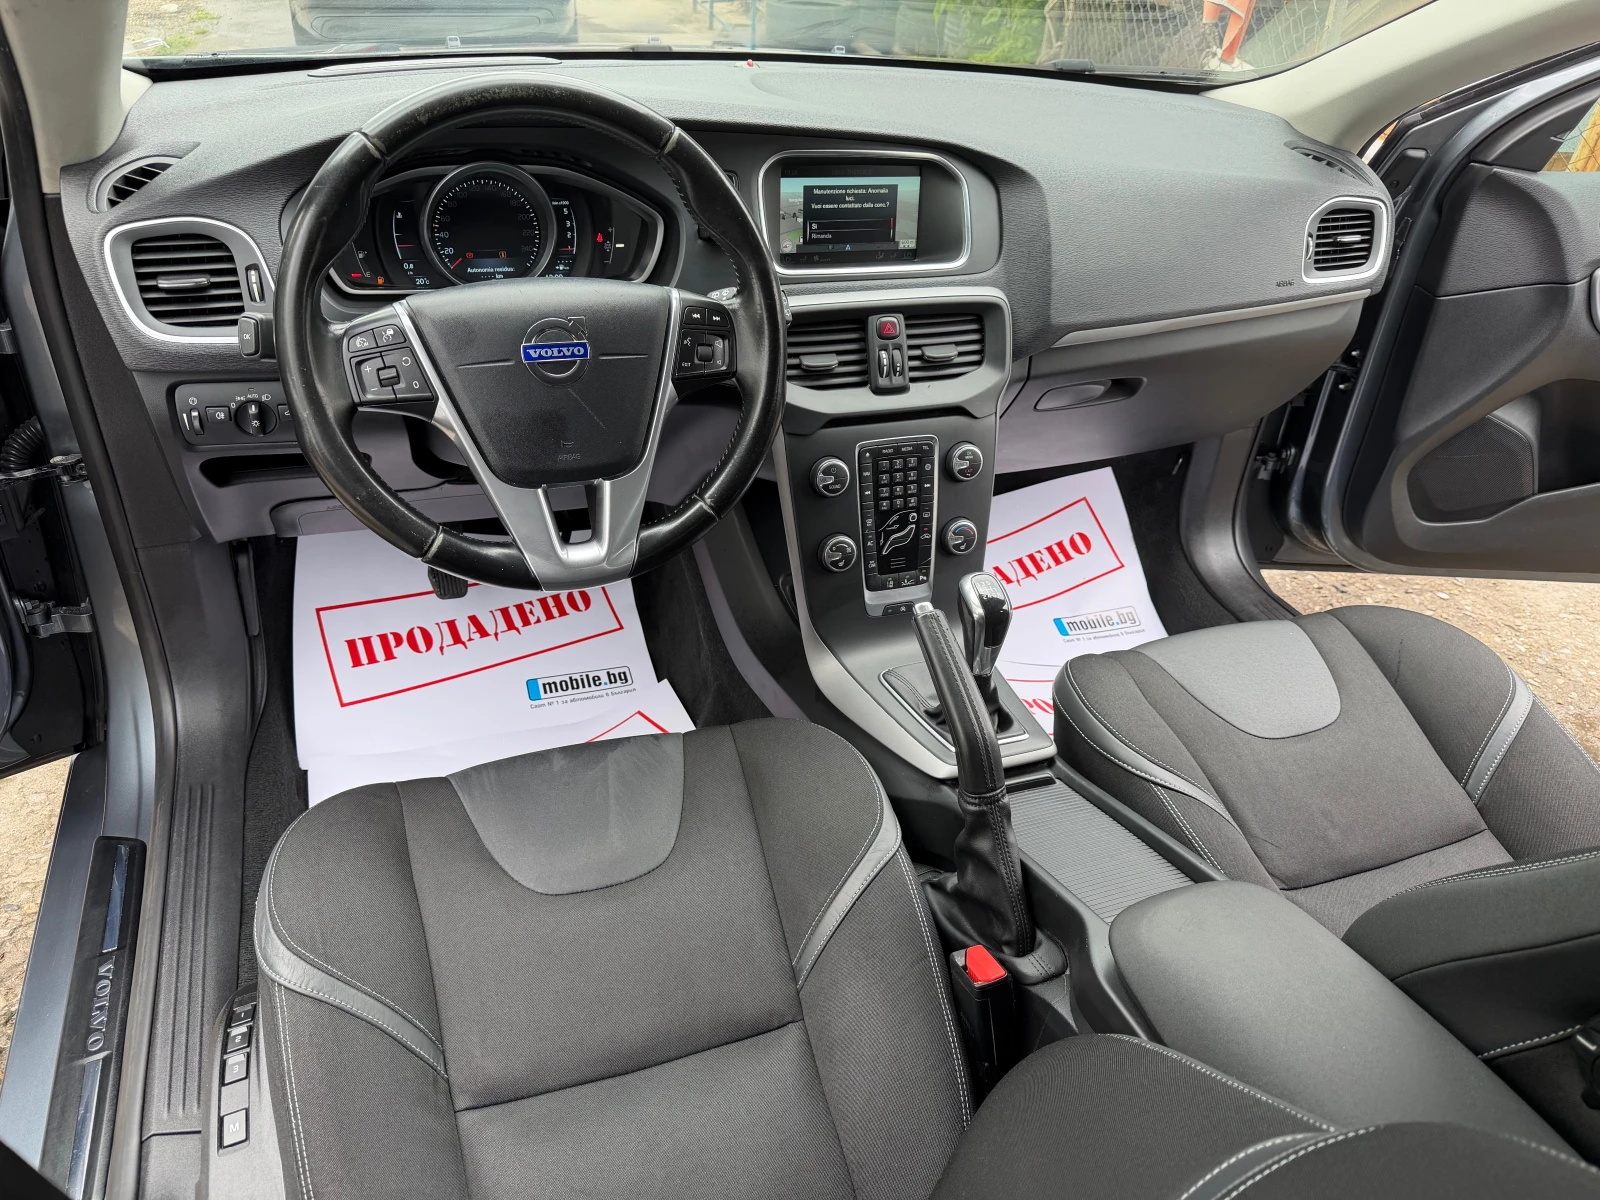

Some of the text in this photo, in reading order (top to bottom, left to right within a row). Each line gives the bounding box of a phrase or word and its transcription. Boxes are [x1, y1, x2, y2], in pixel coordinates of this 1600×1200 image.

[439, 231, 449, 239] 40
[444, 247, 454, 255] 20
[526, 346, 585, 359] VOLVO
[558, 453, 581, 461] AIRBAG
[991, 531, 1092, 587] АДЕНО
[1066, 610, 1137, 632] mobile.bg
[344, 590, 592, 669] ПРОДАДЕНО
[542, 670, 629, 695] mobile.bg
[530, 702, 547, 710] Сайт
[569, 694, 605, 703] автомобили
[87, 955, 116, 1051] VOLVO
[235, 1035, 242, 1043] 2
[233, 1065, 239, 1073] 3
[229, 1122, 240, 1133] M
